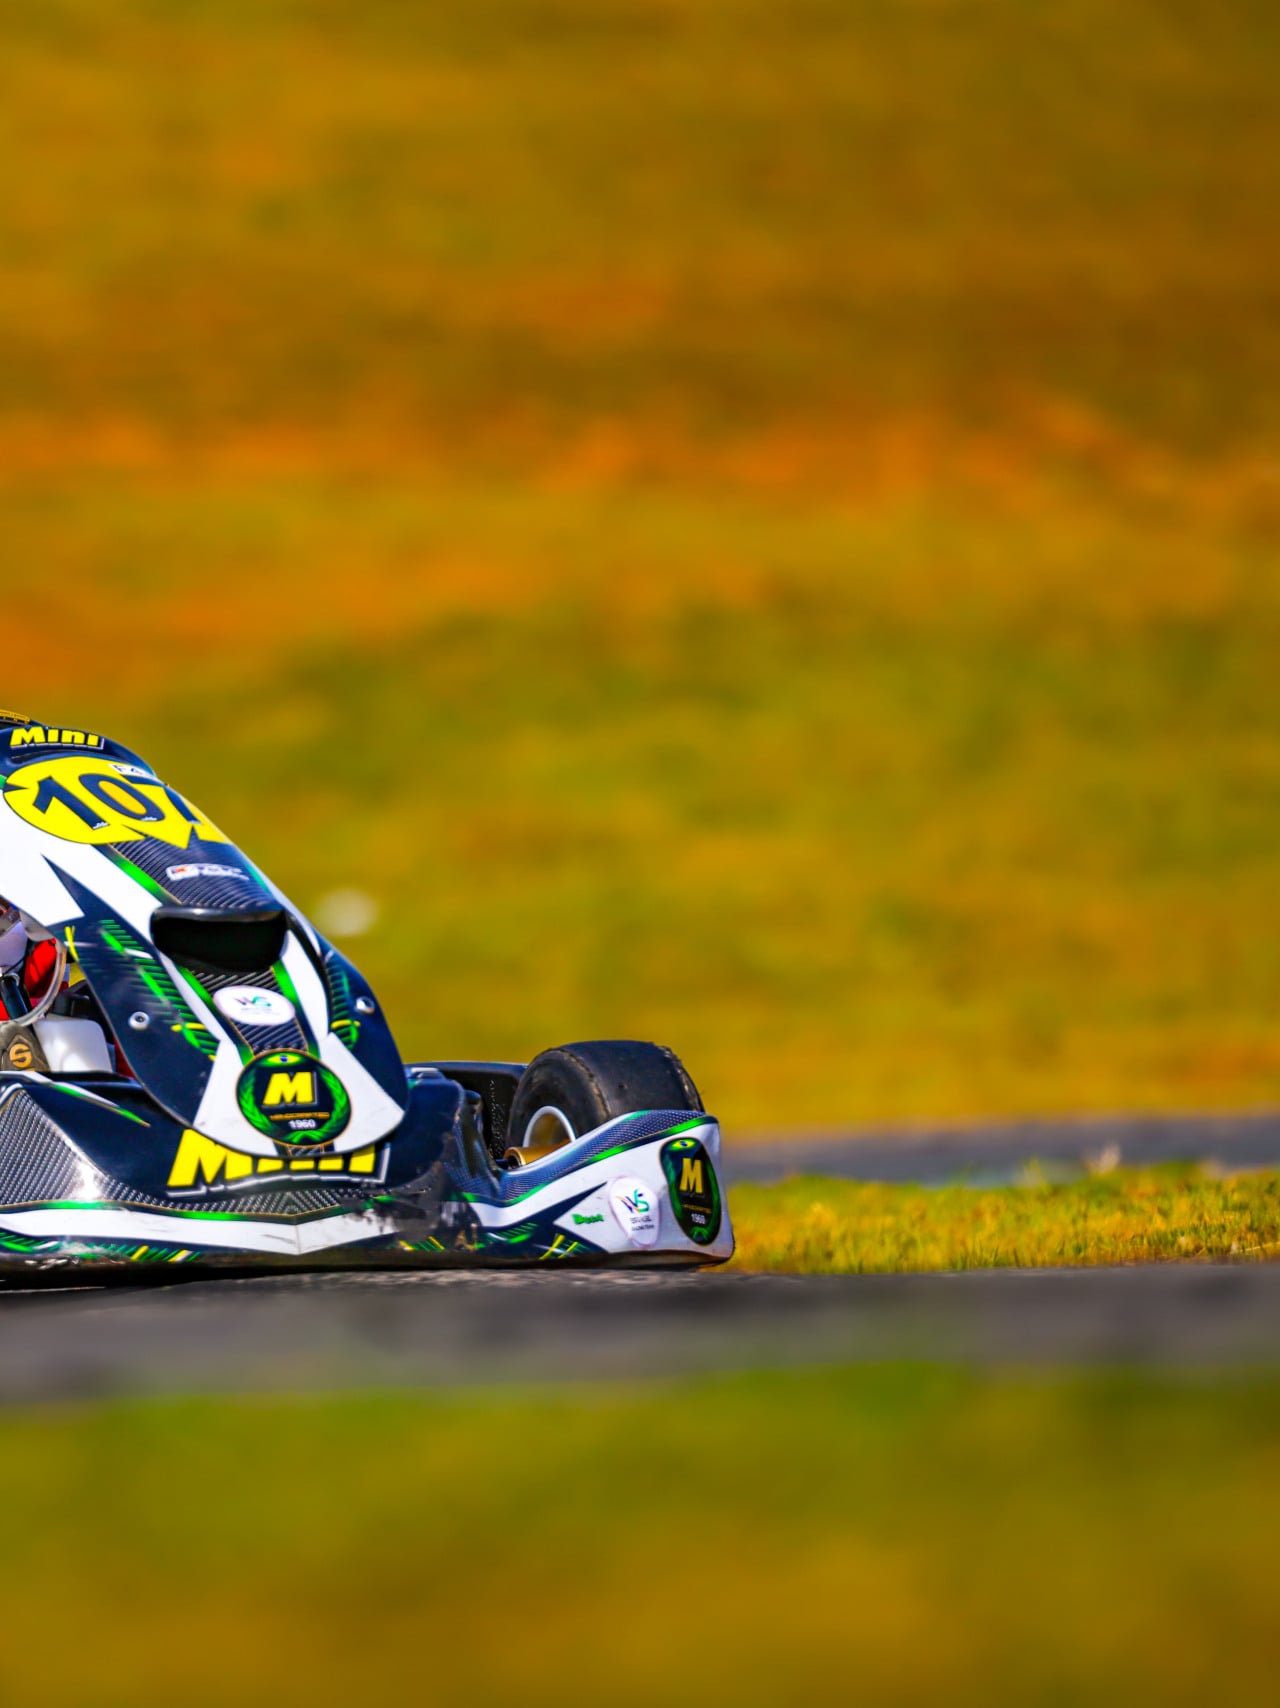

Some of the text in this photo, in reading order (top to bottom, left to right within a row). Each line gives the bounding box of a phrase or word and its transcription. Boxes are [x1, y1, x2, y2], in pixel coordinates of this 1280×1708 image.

[10, 726, 101, 747] Mini
[32, 773, 202, 831] 107
[263, 1072, 314, 1105] M
[679, 1157, 704, 1194] M
